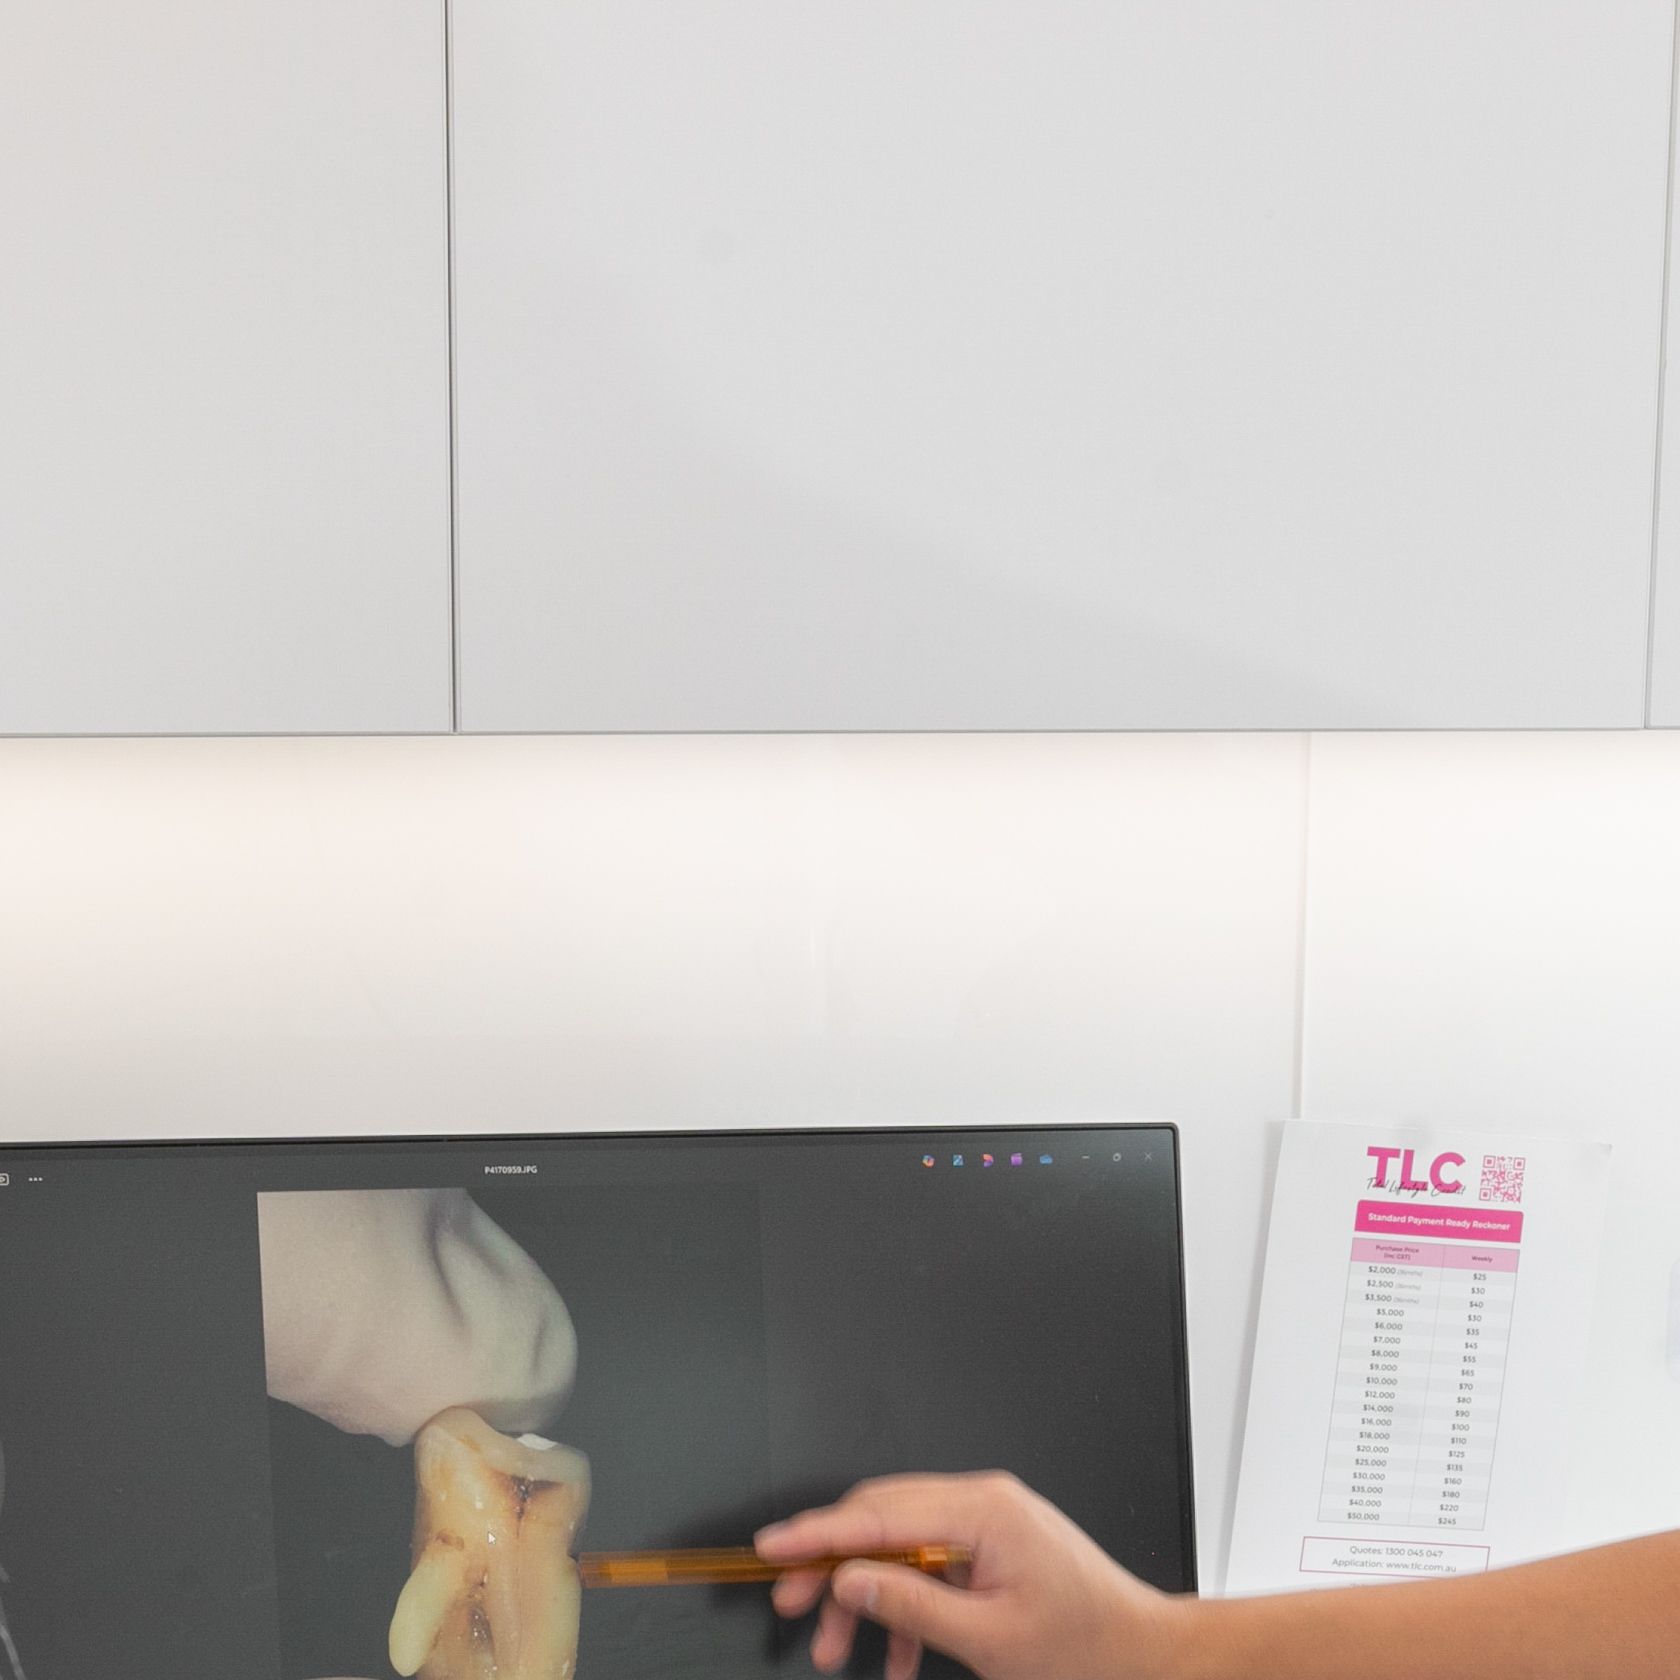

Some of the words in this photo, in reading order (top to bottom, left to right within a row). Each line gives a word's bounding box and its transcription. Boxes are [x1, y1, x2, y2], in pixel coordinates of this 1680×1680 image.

[1367, 1146, 1466, 1193] TLC
[1368, 1213, 1406, 1223] Standard
[1408, 1216, 1443, 1226] Payment
[1446, 1219, 1470, 1229] Ready
[1472, 1221, 1510, 1230] Reckoner
[1471, 1287, 1485, 1295] $30
[1455, 1410, 1469, 1418] $90
[1440, 1504, 1458, 1512] $220
[1350, 1546, 1382, 1555] Quotes:
[1386, 1548, 1405, 1556] 1300
[1407, 1549, 1424, 1557] 045
[1426, 1550, 1443, 1558] 047
[1332, 1558, 1384, 1568] Application:
[1386, 1562, 1456, 1573] www.tlc.com.au
